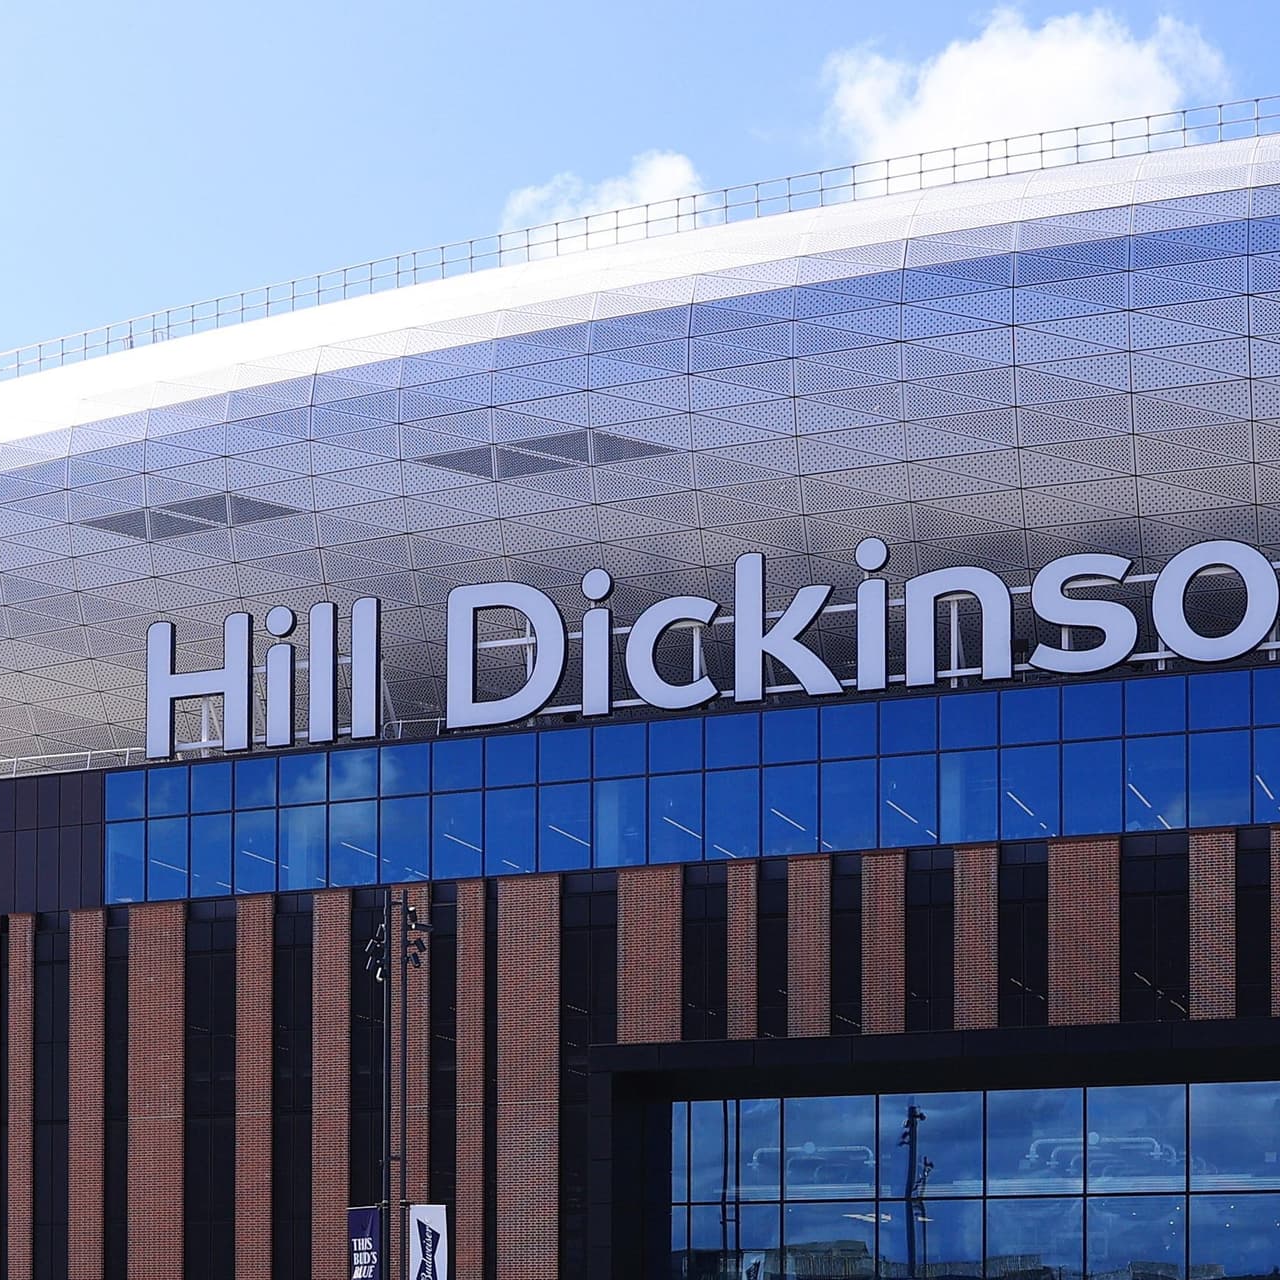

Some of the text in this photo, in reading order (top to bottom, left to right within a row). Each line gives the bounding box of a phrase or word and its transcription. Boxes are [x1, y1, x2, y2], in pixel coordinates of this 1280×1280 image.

[146, 595, 382, 761] Hill
[352, 1237, 373, 1251] THIS
[352, 1265, 376, 1279] BLUE
